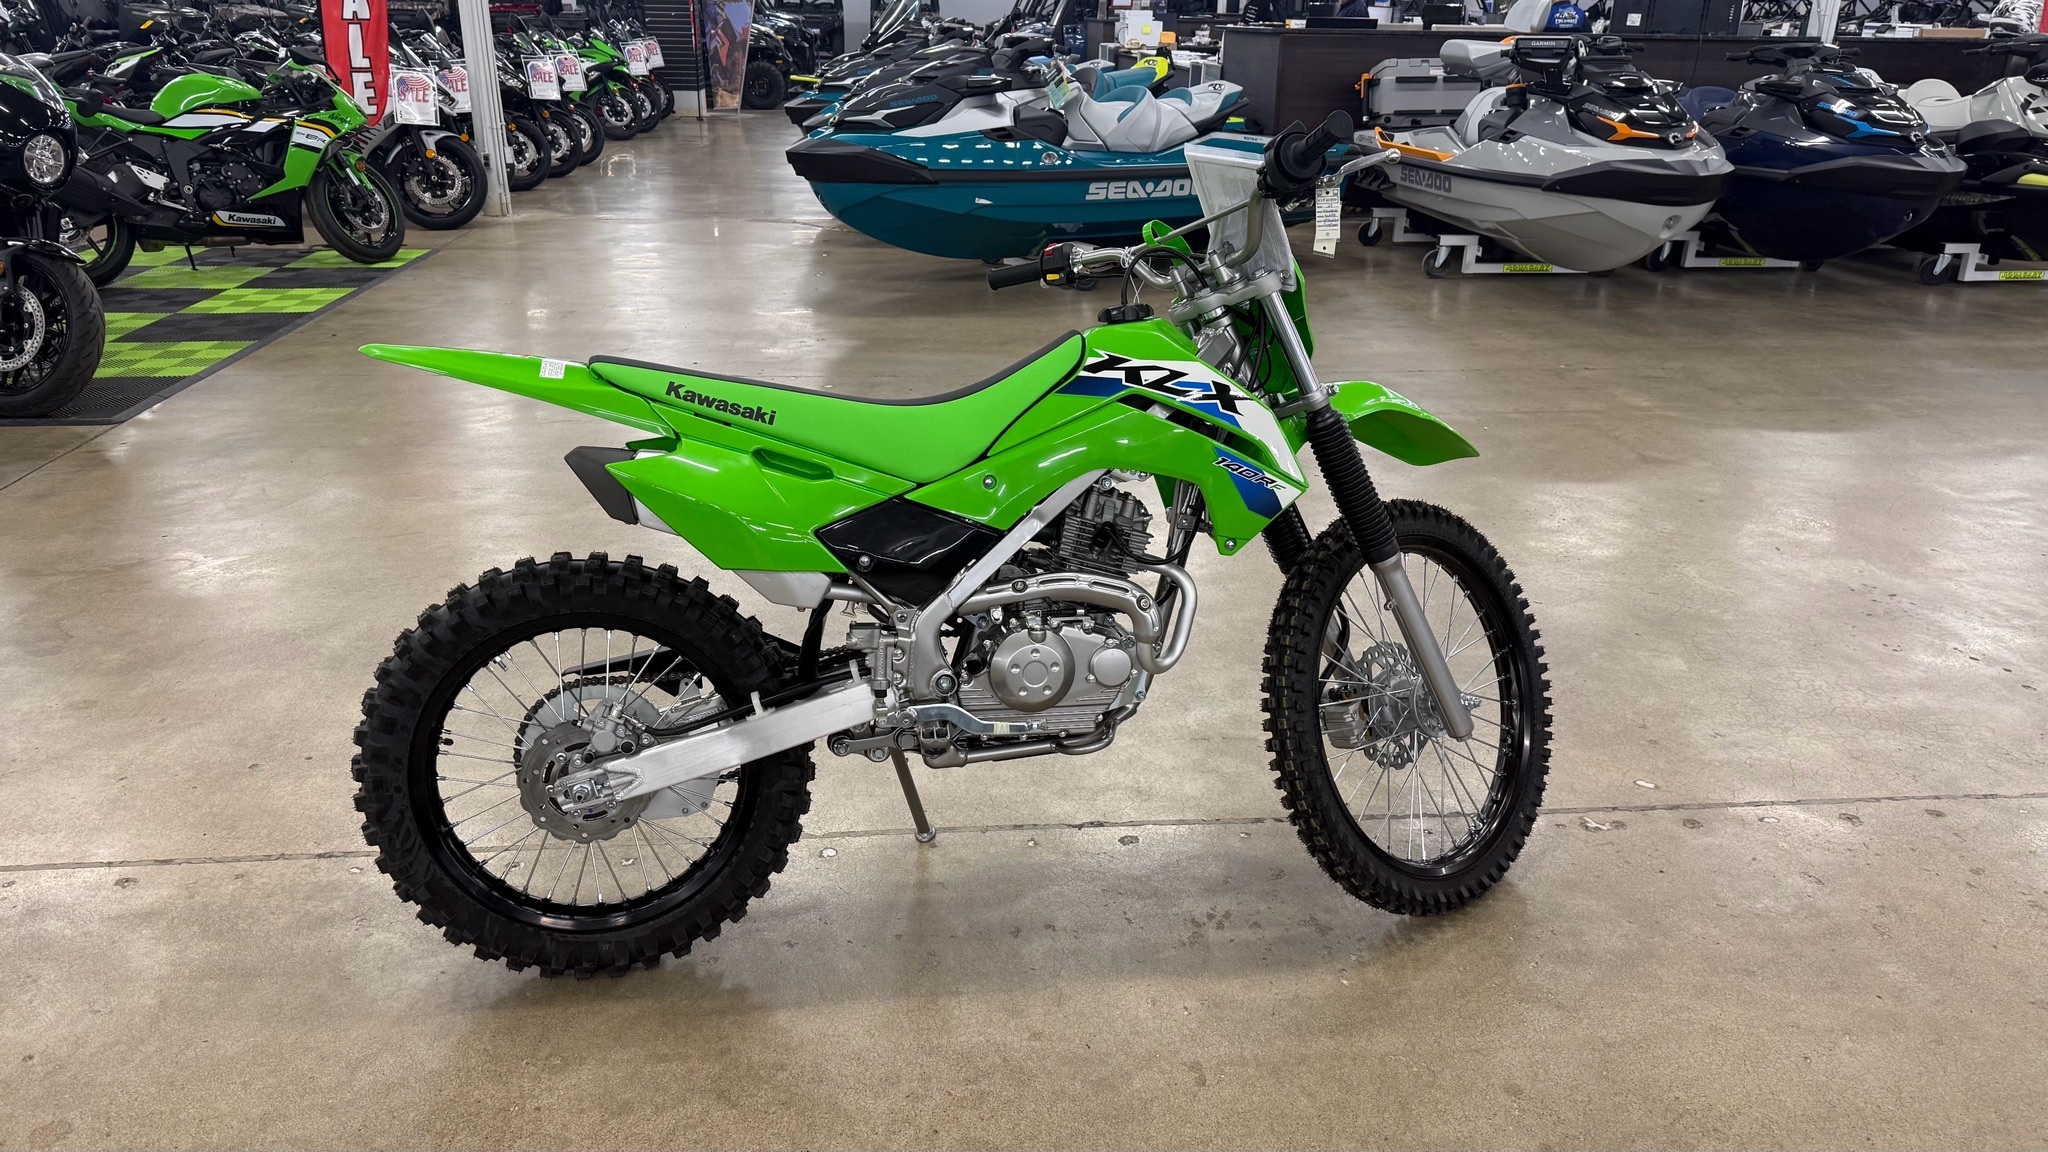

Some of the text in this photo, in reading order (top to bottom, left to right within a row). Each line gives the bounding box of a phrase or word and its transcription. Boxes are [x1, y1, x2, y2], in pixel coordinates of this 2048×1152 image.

[629, 54, 643, 63] SALE
[532, 71, 554, 83] SALE
[561, 64, 580, 76] SALE
[399, 86, 431, 103] SALE
[227, 213, 277, 225] Kawasaki
[1082, 353, 1257, 417] KLX
[665, 380, 777, 427] Kawasaki
[1212, 456, 1287, 491] 140RF
